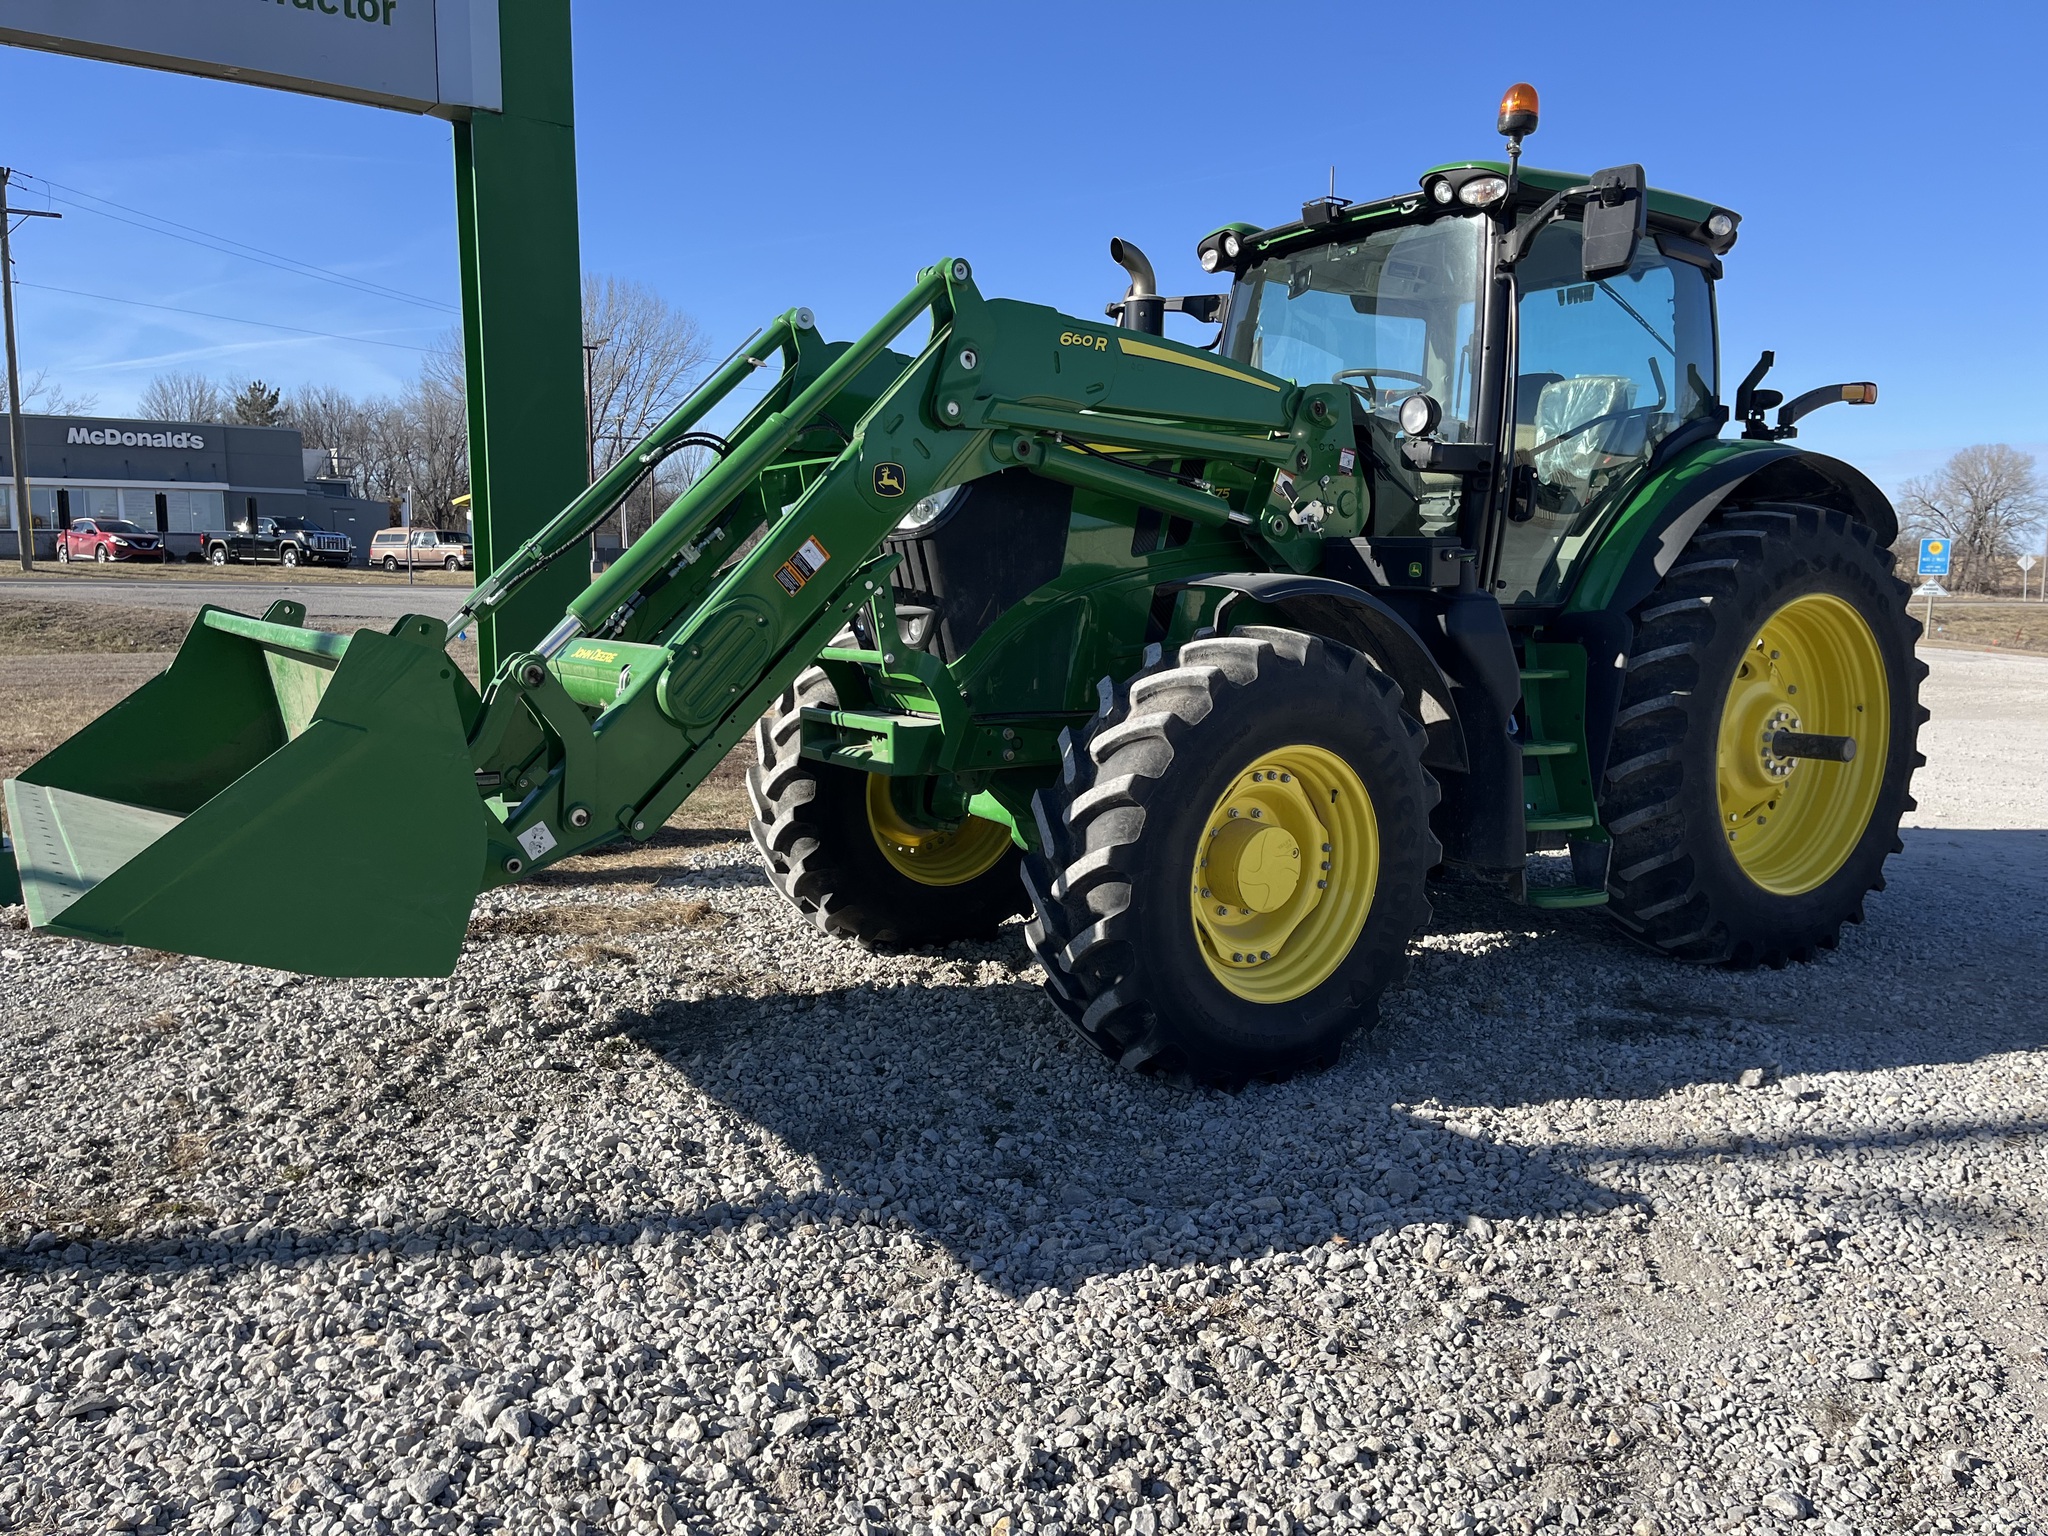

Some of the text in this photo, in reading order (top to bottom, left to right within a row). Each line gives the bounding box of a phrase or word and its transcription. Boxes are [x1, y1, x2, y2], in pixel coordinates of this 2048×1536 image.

[263, 0, 397, 26] ctor
[67, 427, 205, 450] McDonald's
[591, 649, 618, 662] DEERE
